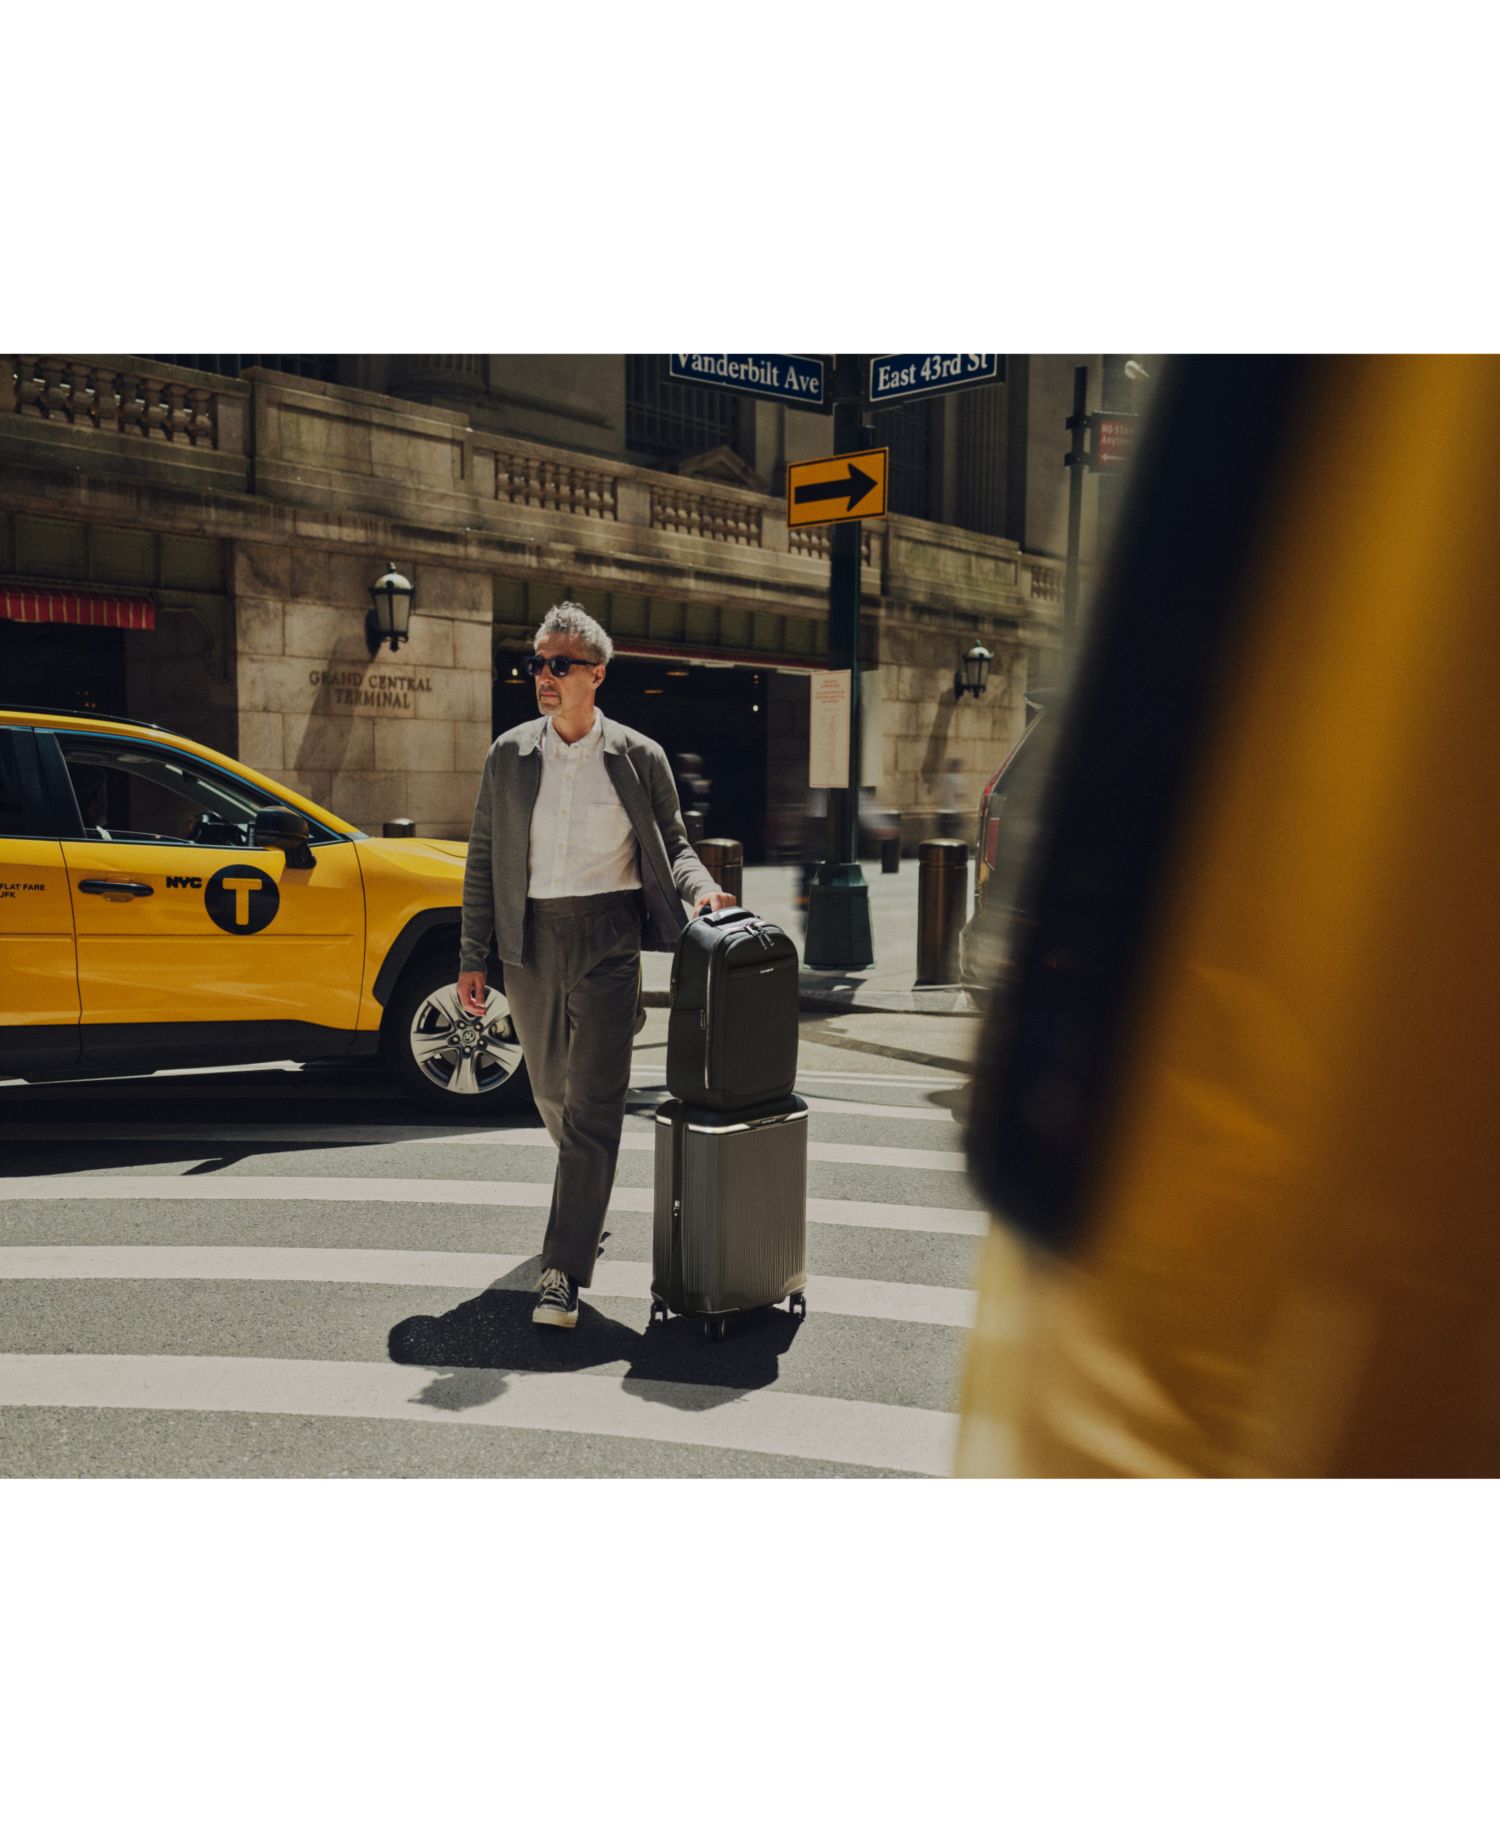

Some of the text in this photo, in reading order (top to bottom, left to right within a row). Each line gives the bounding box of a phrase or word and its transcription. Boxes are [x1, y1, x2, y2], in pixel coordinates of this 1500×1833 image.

[678, 354, 819, 394] Vanderbilt Ave
[877, 354, 988, 391] East 43rd St
[309, 670, 433, 692] GRAND CENTRAL
[334, 687, 410, 710] TERMINAL
[0, 883, 45, 891] FLAT FARE
[0, 891, 16, 899] JFK
[166, 876, 262, 925] NYC T
